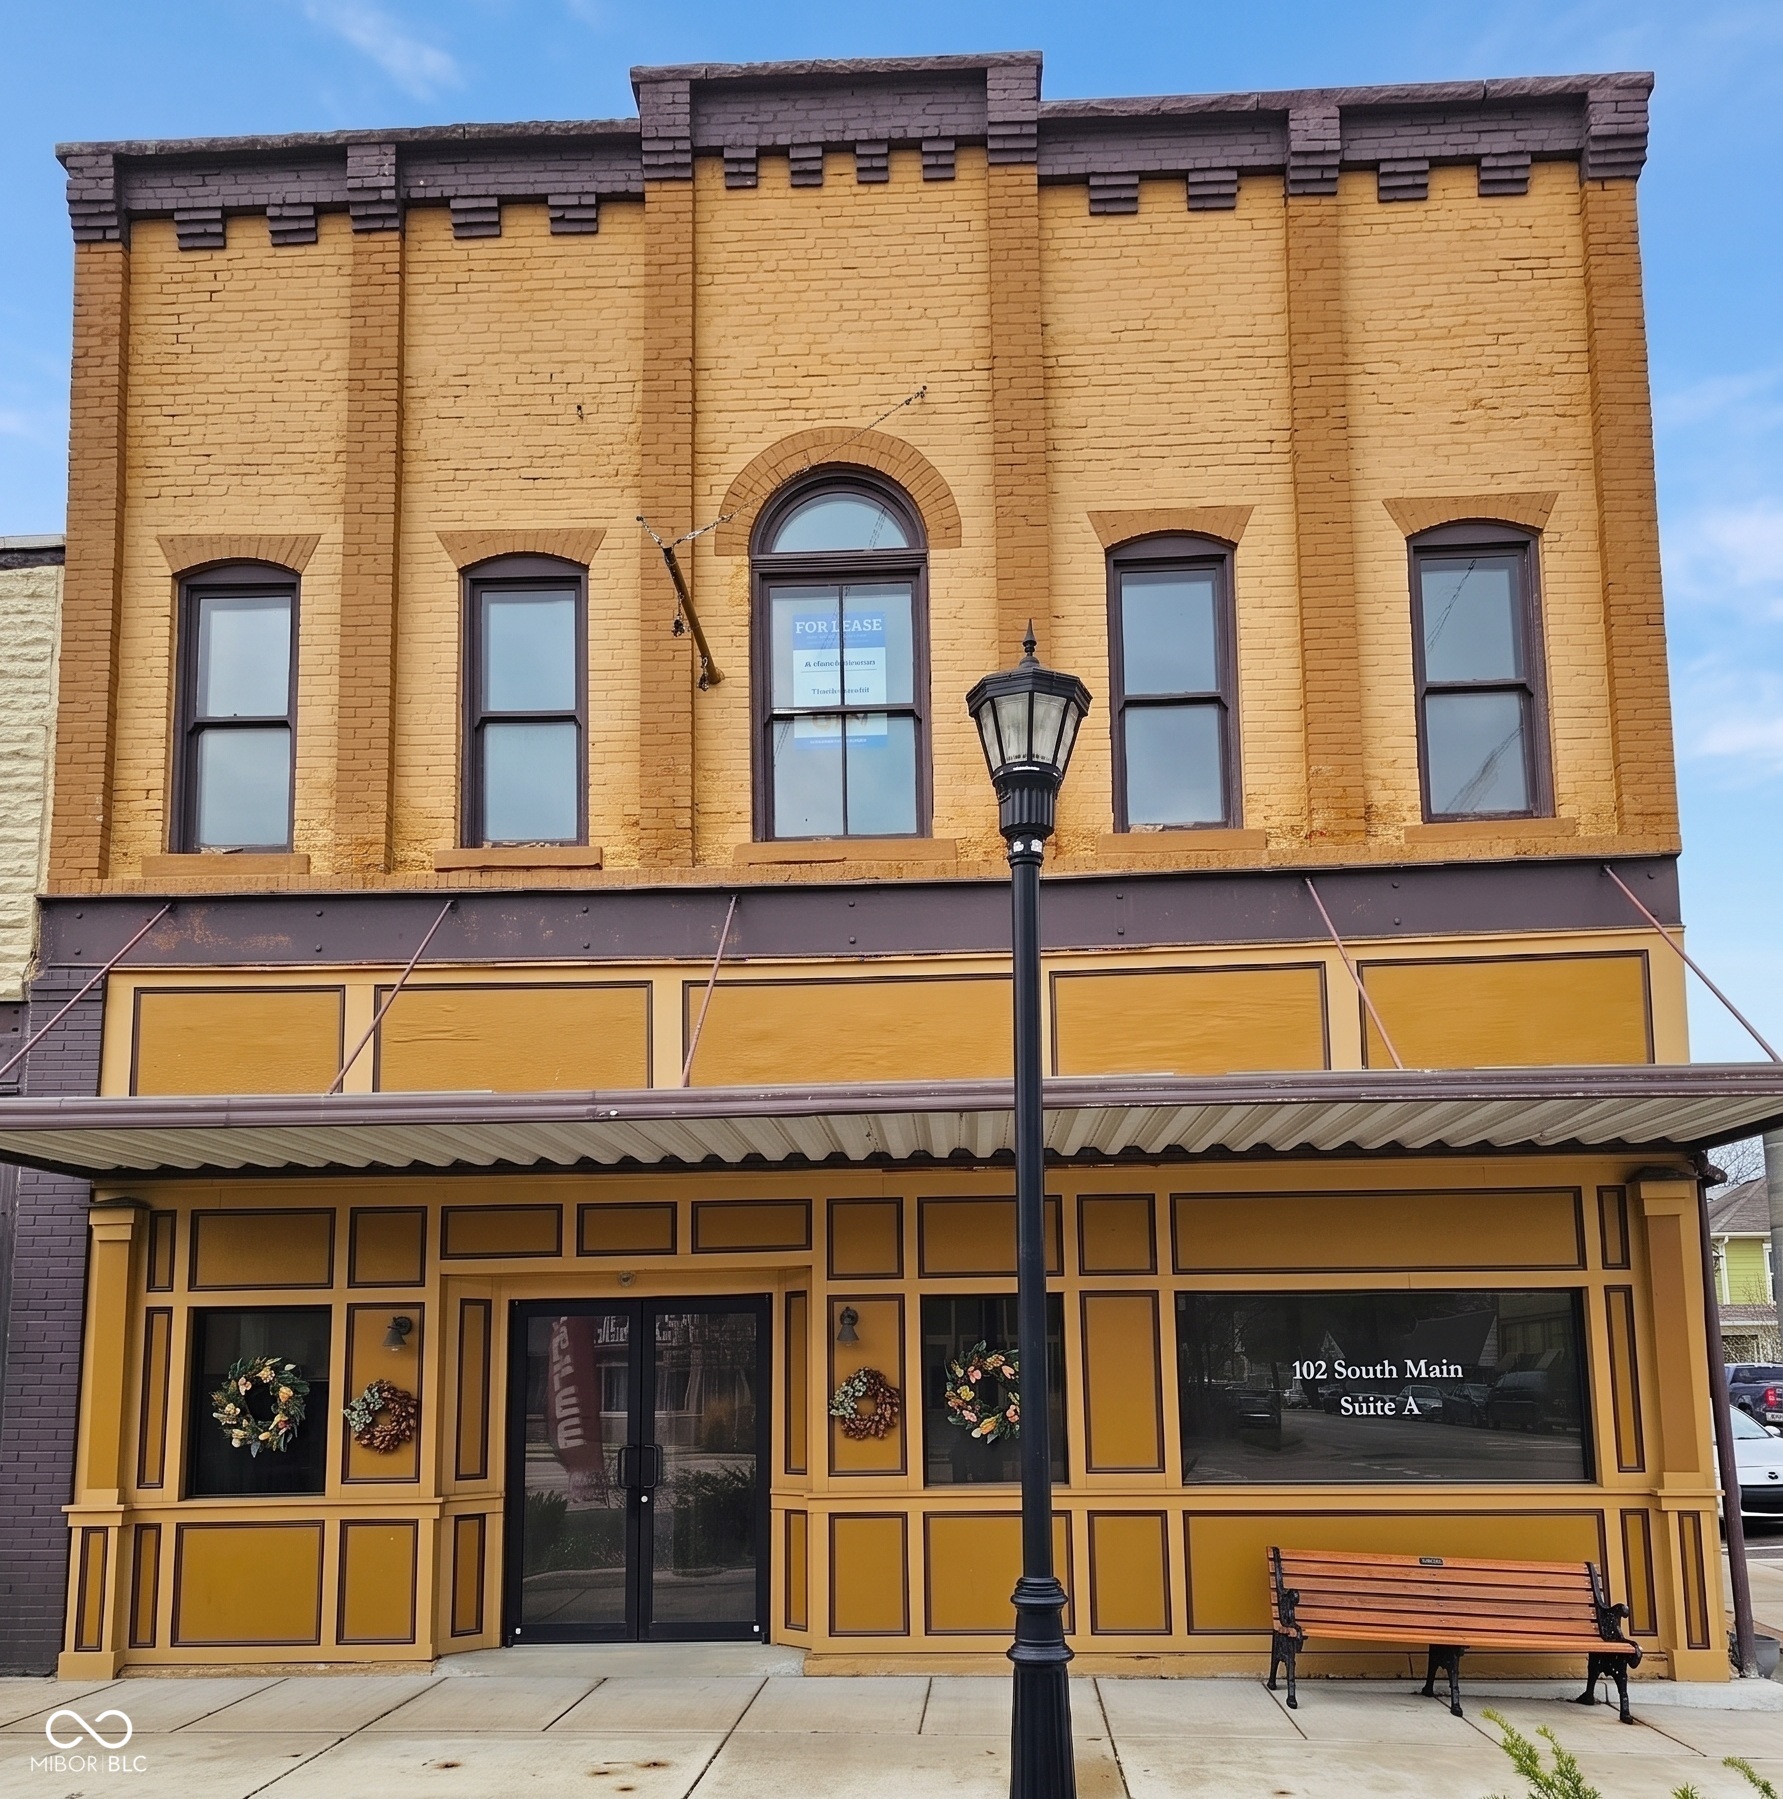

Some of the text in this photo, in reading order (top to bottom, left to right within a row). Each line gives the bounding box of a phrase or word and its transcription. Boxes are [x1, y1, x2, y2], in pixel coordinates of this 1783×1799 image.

[795, 618, 882, 634] FOR LEASE
[1292, 1359, 1463, 1380] 102 South Main
[1340, 1396, 1422, 1416] Suite A
